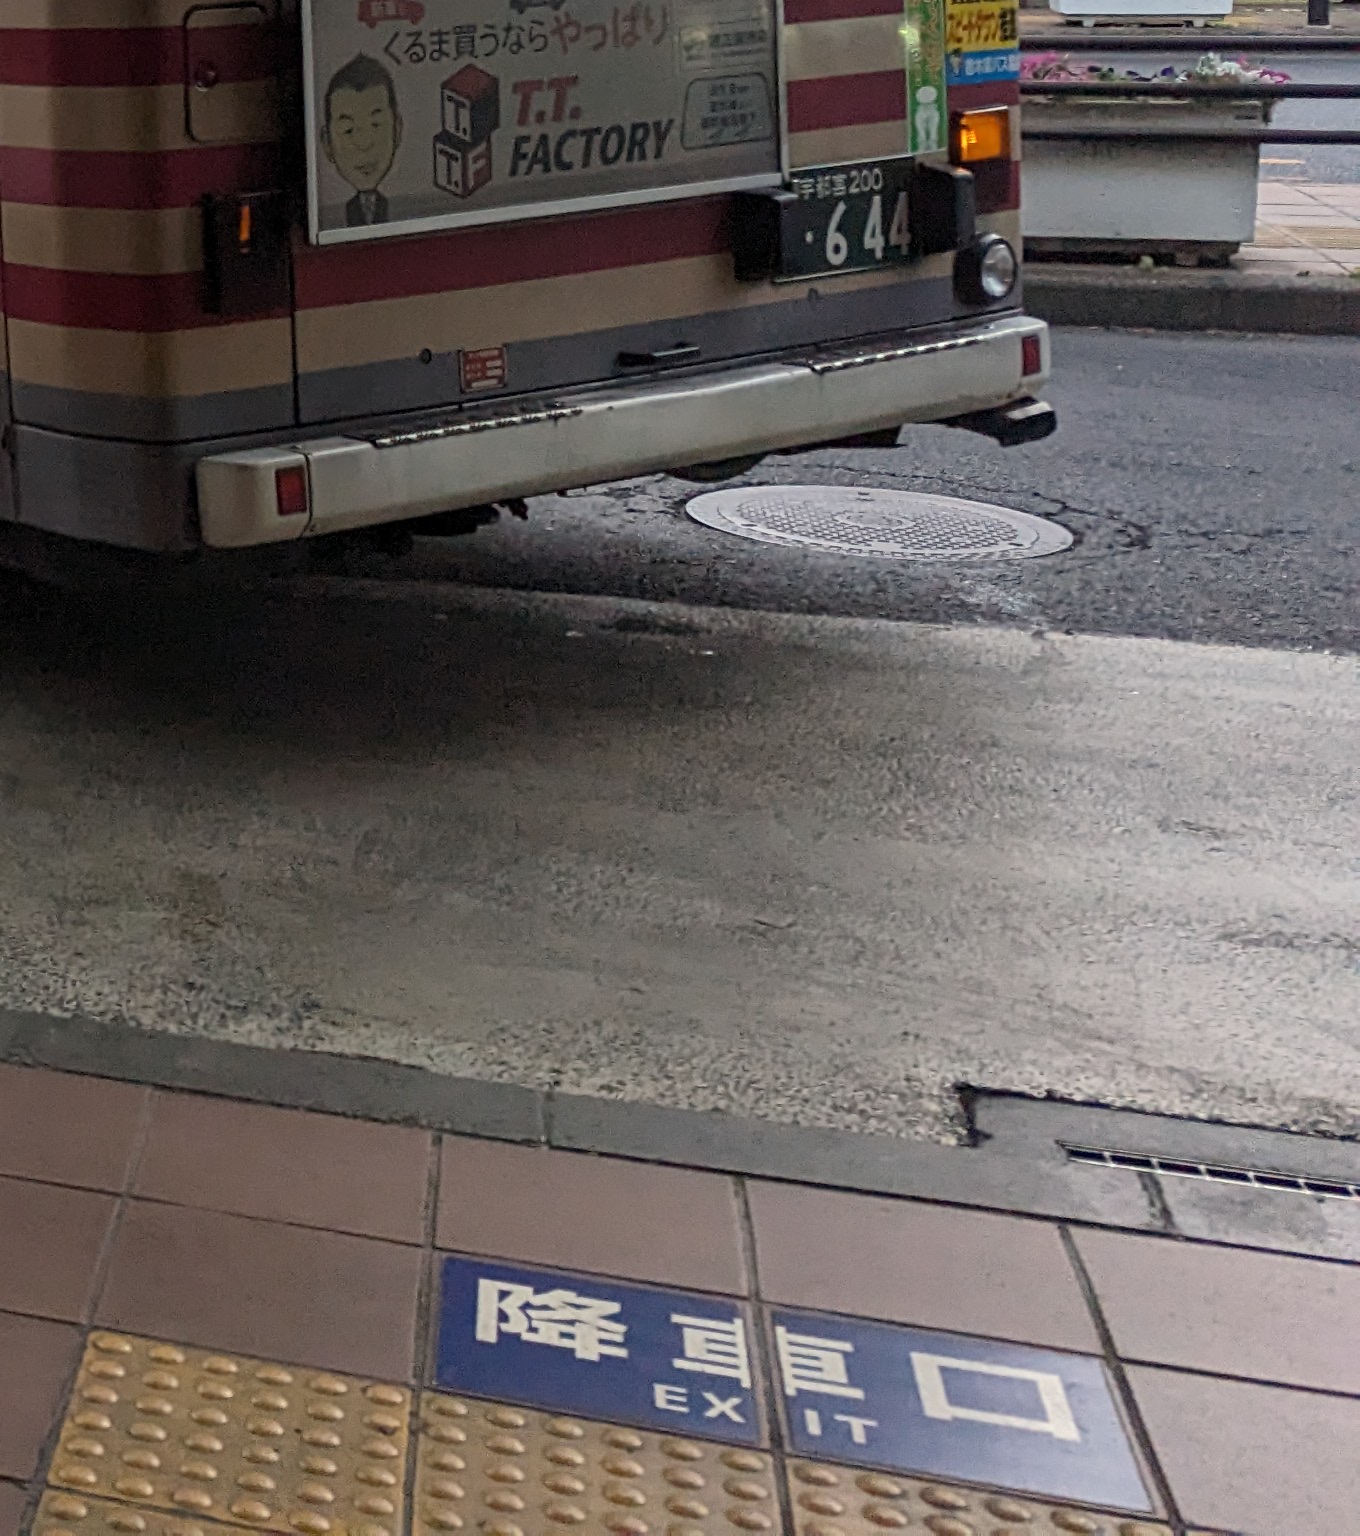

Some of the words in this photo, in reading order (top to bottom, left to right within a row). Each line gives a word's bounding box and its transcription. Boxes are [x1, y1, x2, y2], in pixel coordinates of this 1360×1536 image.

[511, 74, 583, 127] T.T.
[507, 118, 676, 178] FACTORY
[475, 1278, 1080, 1442] 降車口
[653, 1383, 877, 1446] EXIT
